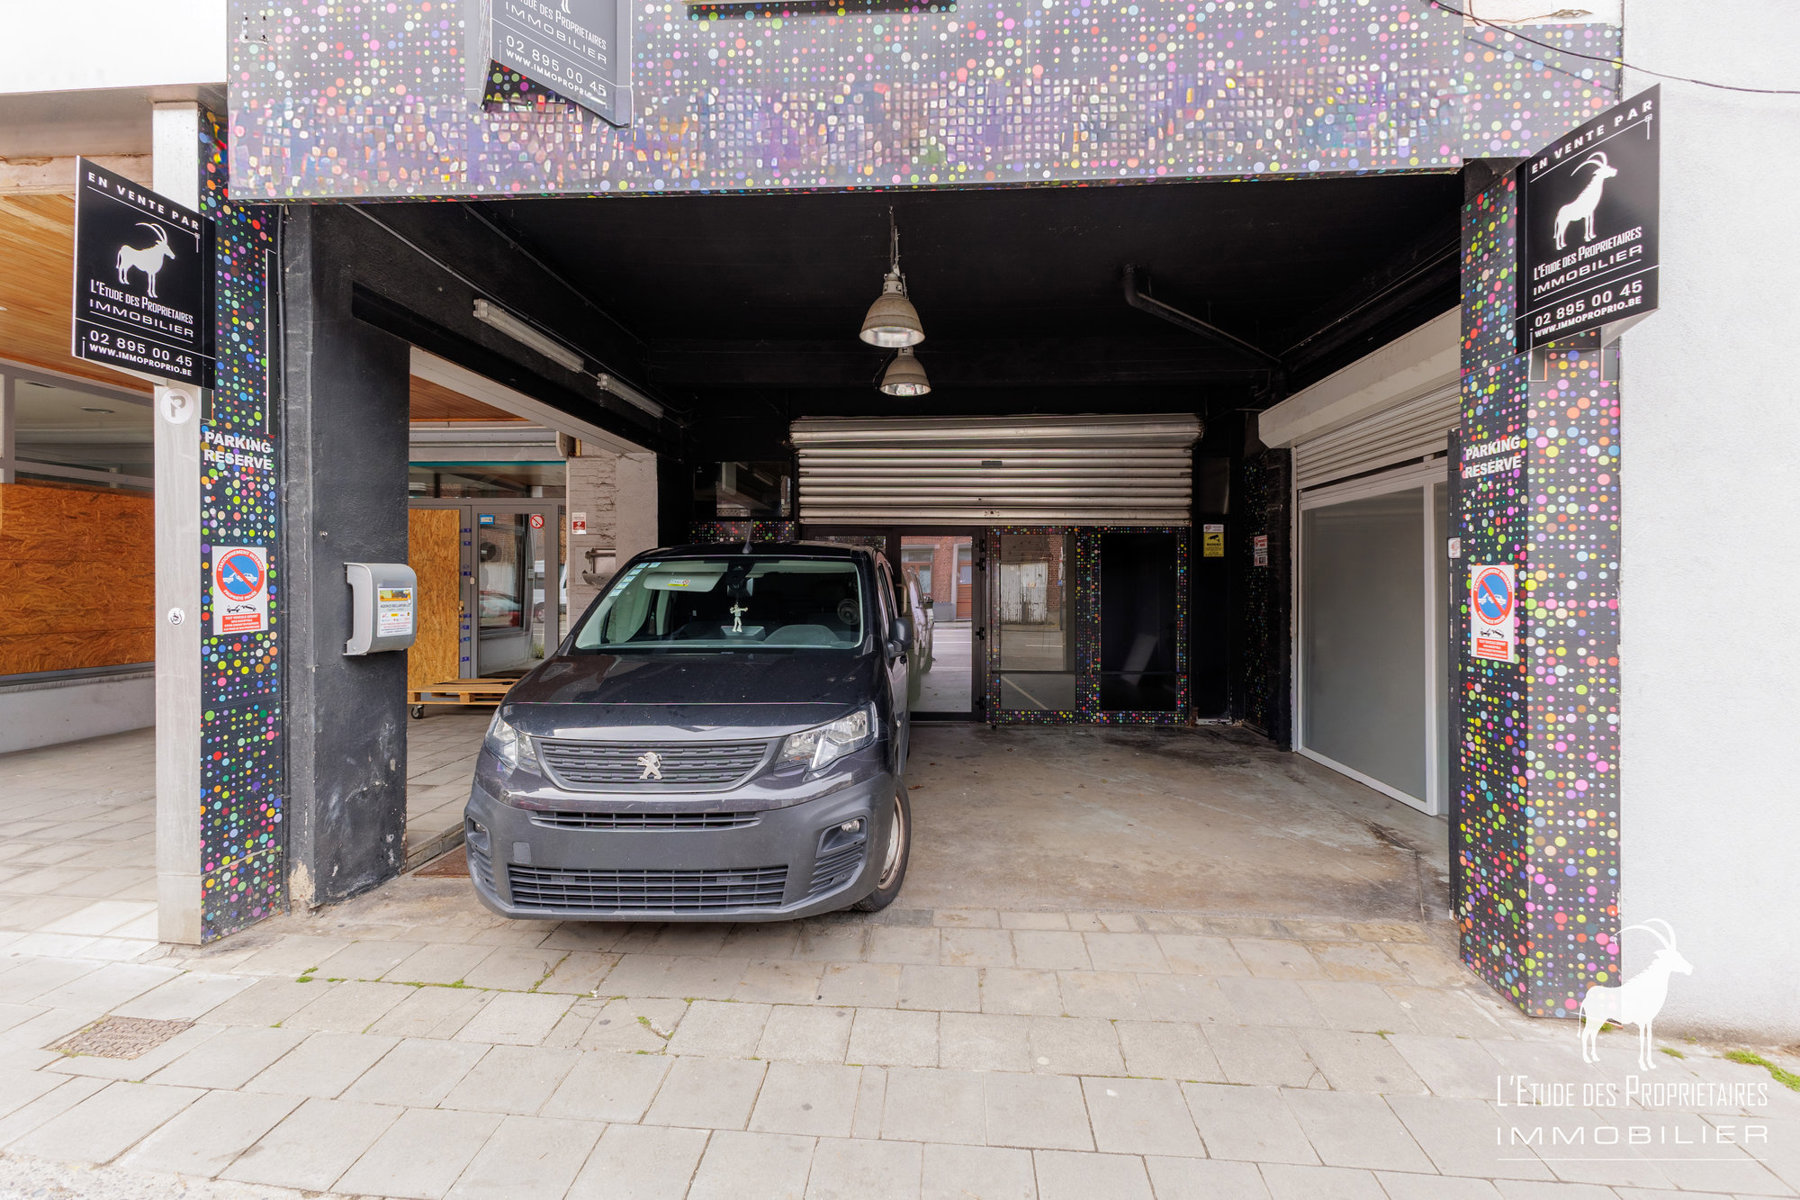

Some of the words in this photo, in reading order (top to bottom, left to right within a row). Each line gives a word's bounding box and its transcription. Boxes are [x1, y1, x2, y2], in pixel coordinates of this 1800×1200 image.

[505, 1, 607, 64] IMMOBILIER
[540, 3, 553, 20] DES
[556, 9, 607, 50] PROPRIETAIRES
[506, 35, 525, 53] 02
[531, 49, 560, 72] 895
[566, 67, 583, 84] 00
[589, 81, 607, 97] 45
[1531, 157, 1548, 174] EN
[1554, 125, 1605, 160] VENTE
[1614, 100, 1653, 127] PAR
[88, 171, 108, 188] EN
[116, 184, 165, 214] VENTE
[171, 210, 199, 230] PAR
[1562, 252, 1577, 269] DES
[1578, 226, 1642, 262] PROPRIETAIRES
[1533, 244, 1643, 296] IMMOBILIER
[89, 299, 194, 338] IMMOBILIER
[90, 279, 124, 302] L'ETUDE
[125, 293, 140, 307] DES
[141, 296, 194, 325] PROPRIETAIRES
[1534, 295, 1642, 338] WWW.IMMOPROPRIO.BE
[1535, 312, 1551, 327] 02
[1556, 299, 1585, 320] 895
[1591, 290, 1612, 307] 00
[1619, 279, 1643, 297] 45
[89, 343, 192, 377] WWW.IMMOPROPRIO.BE
[90, 330, 110, 345] 02
[116, 337, 146, 354] 895
[152, 347, 170, 361] 00
[175, 355, 193, 367] 45
[203, 448, 273, 471] RESERVE
[204, 431, 272, 454] PARKING
[1465, 436, 1521, 461] PARKING
[1464, 454, 1522, 479] RESERVE
